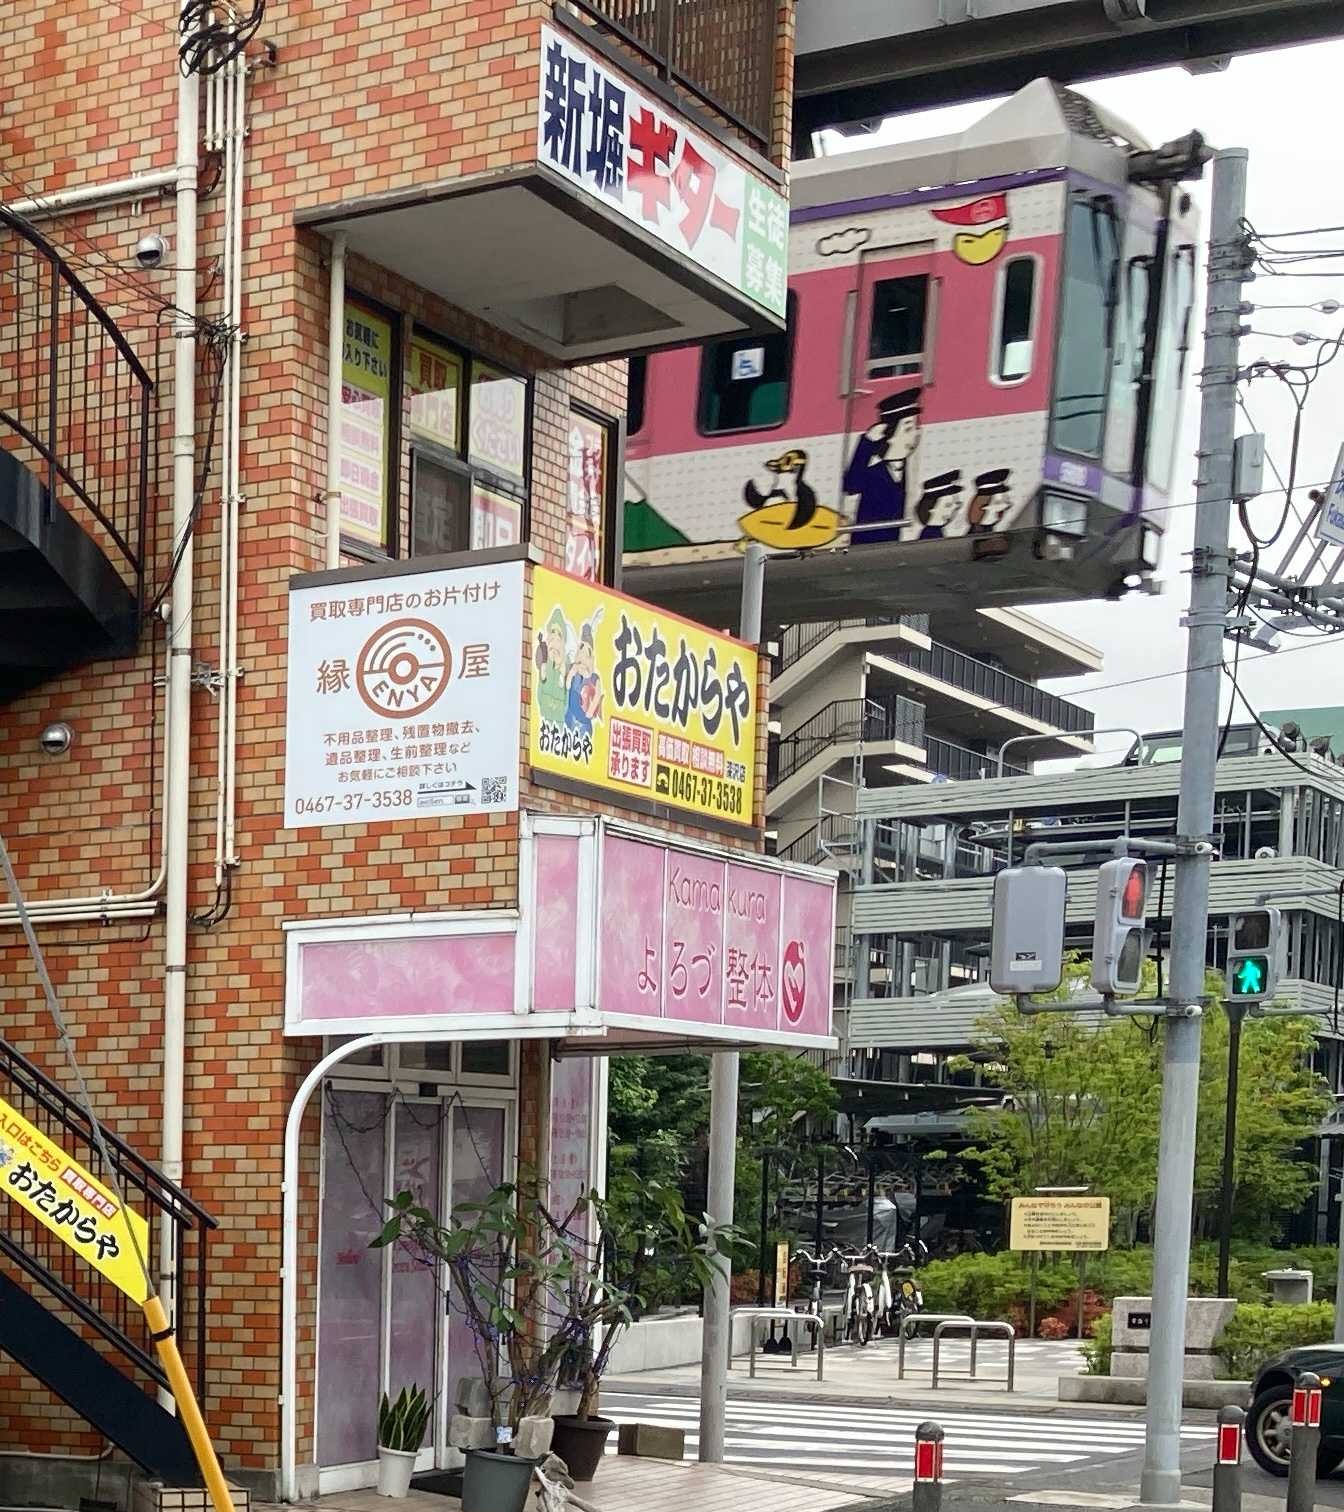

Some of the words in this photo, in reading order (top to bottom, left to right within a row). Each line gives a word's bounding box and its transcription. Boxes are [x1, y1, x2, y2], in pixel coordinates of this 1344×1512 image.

[544, 40, 741, 251] 新堀ギター
[310, 581, 501, 622] 買取専門店のお片付け
[372, 675, 437, 707] ENYA
[613, 614, 750, 746] おたからや
[325, 742, 472, 767] 遺品整理、生前整理など
[539, 721, 593, 766] おたからや
[338, 762, 457, 784] お気軽にご相談下さい
[672, 769, 743, 815] 0467-37-3538
[295, 789, 413, 815] 0467-37-3538
[637, 933, 776, 1009] よろづ整体
[8, 1161, 120, 1260] おたからや
